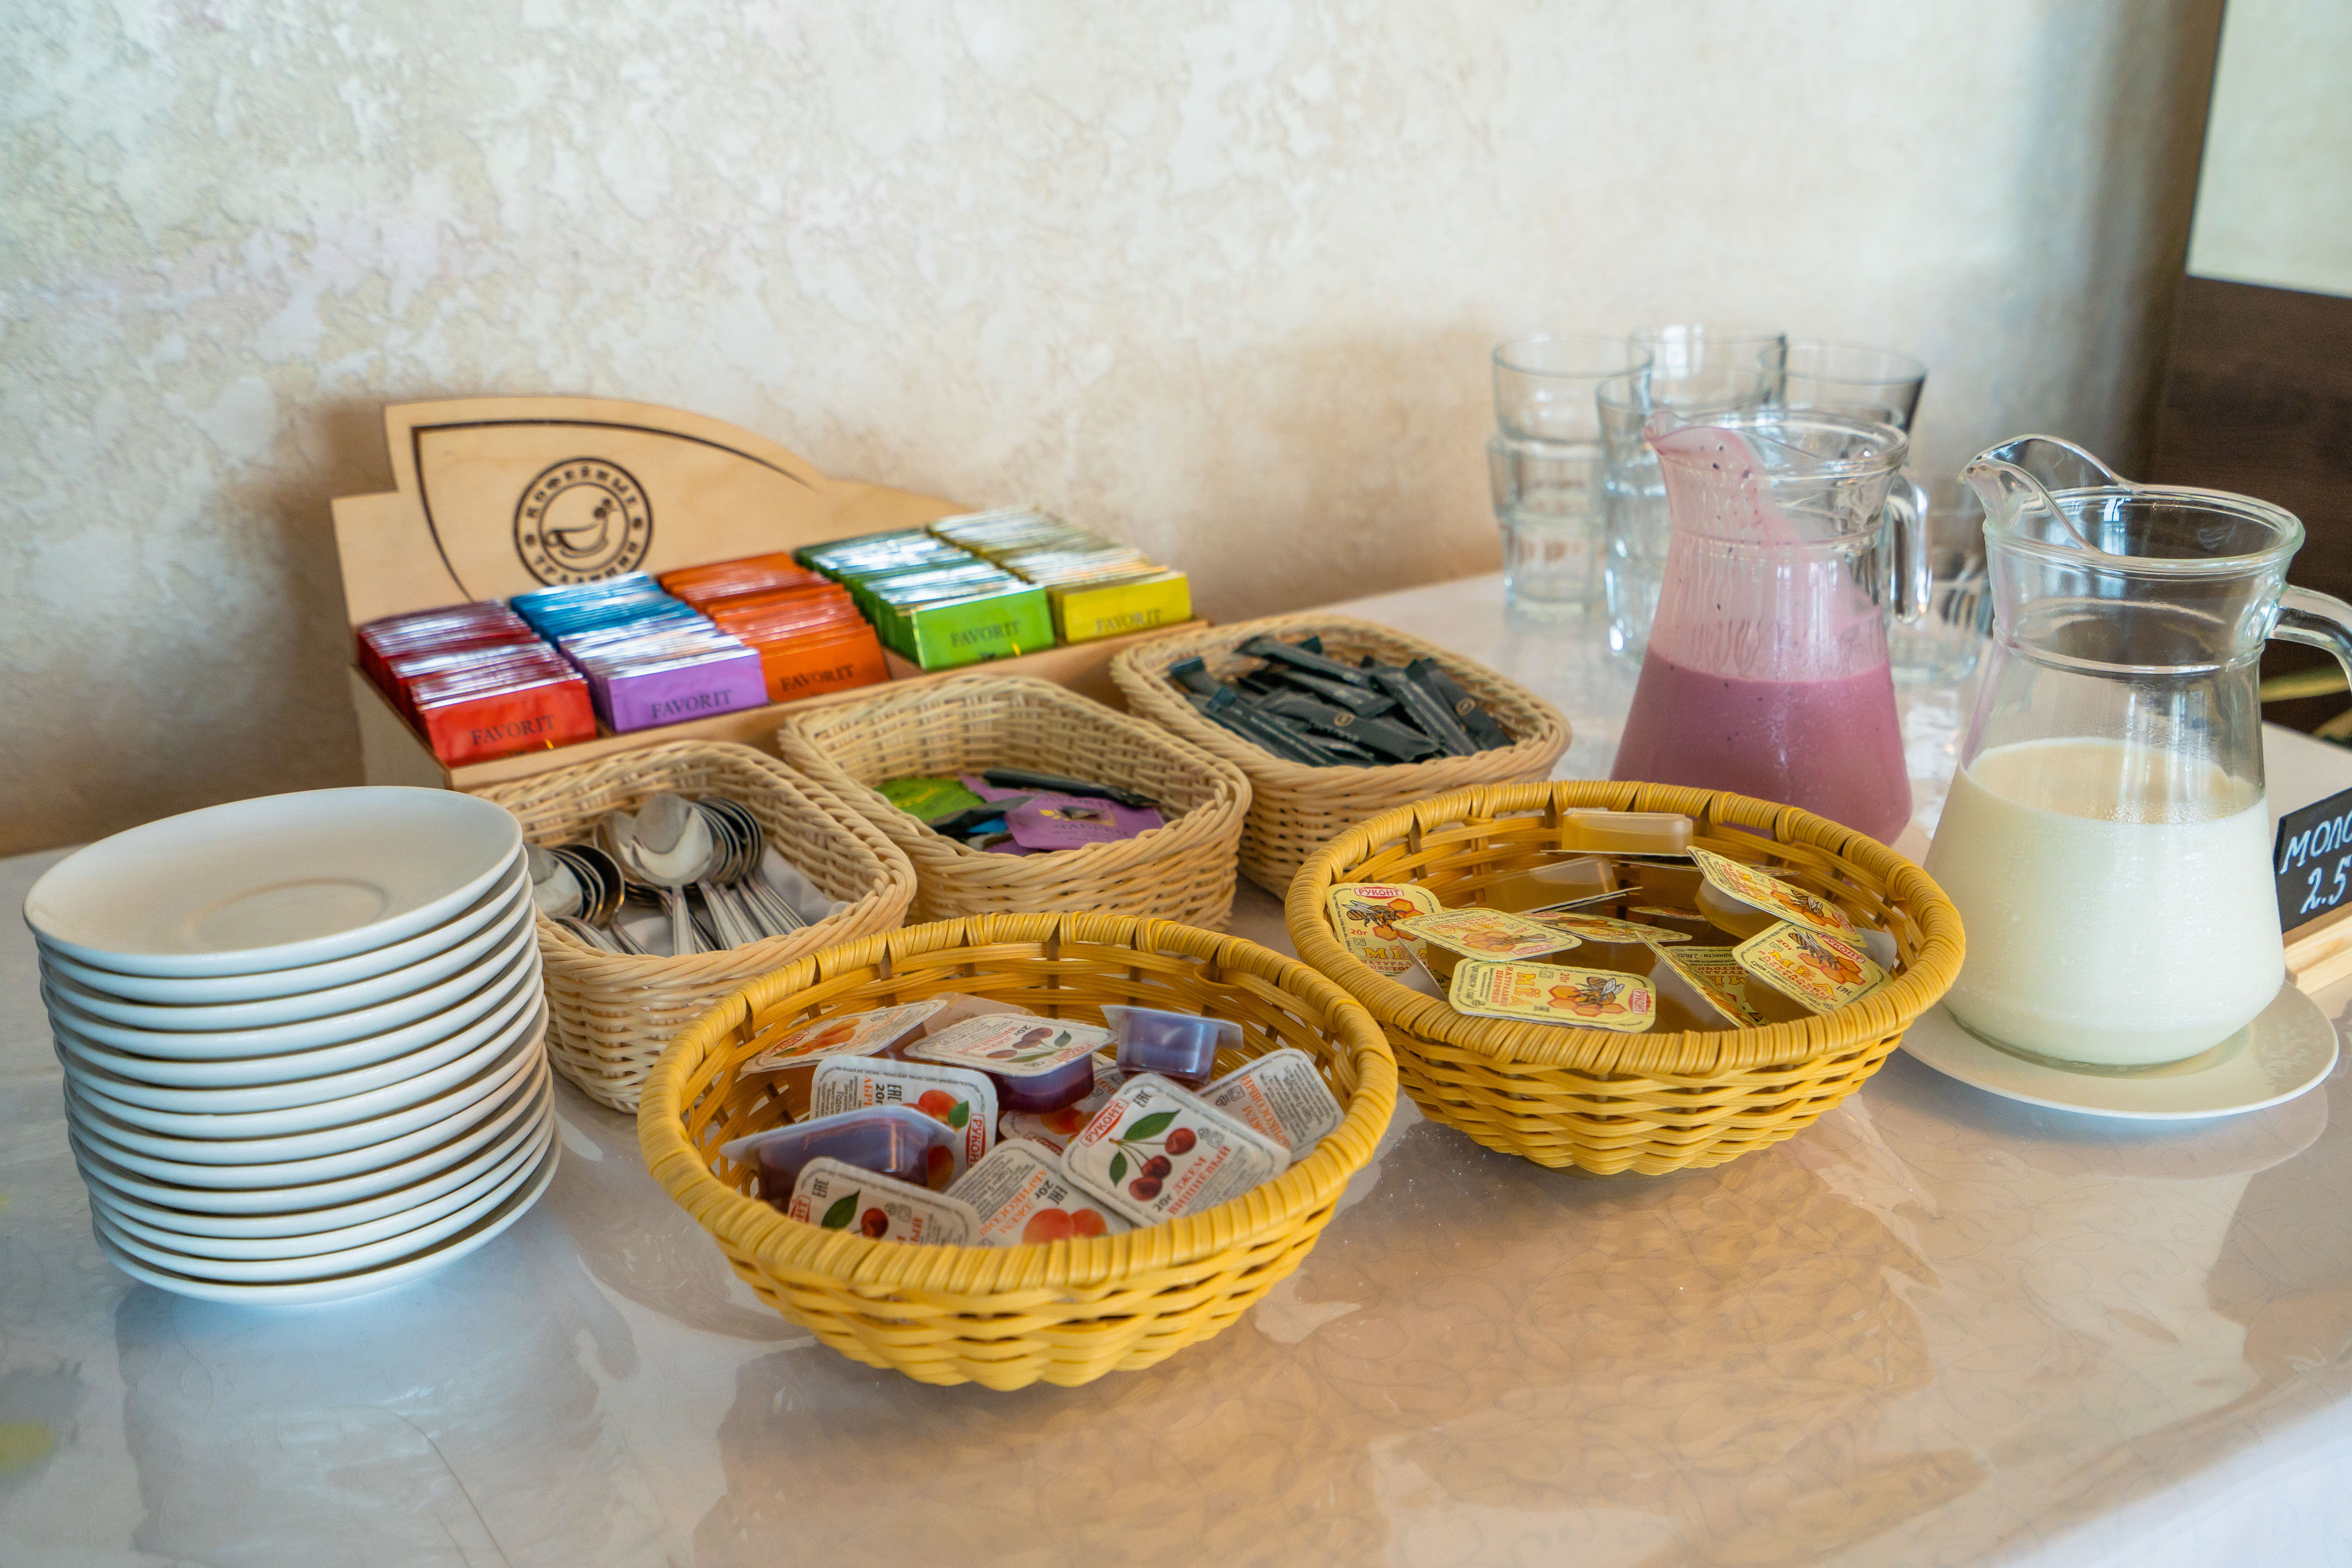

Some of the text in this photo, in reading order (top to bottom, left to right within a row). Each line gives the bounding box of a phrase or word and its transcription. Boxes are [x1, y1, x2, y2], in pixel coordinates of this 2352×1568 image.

[950, 619, 1021, 648] FAVORIT
[780, 662, 854, 692] FAVORIT
[652, 688, 732, 719] FAVORIT
[470, 714, 555, 746] FAVORIT
[1775, 938, 1794, 951] 20г
[1821, 933, 1861, 961] РУКОНТ
[1751, 960, 1769, 974] Срок
[1767, 971, 1796, 990] годности
[1768, 949, 1835, 998] МЁД
[1509, 972, 1541, 1006] МЁД
[1633, 990, 1646, 1014] РУКОНТ
[835, 1092, 844, 1114] Годен
[875, 1083, 885, 1105] 20г
[1084, 1103, 1124, 1143] РУКОНТ
[969, 1119, 983, 1168] РУКОН
[1034, 1180, 1054, 1200] 20г
